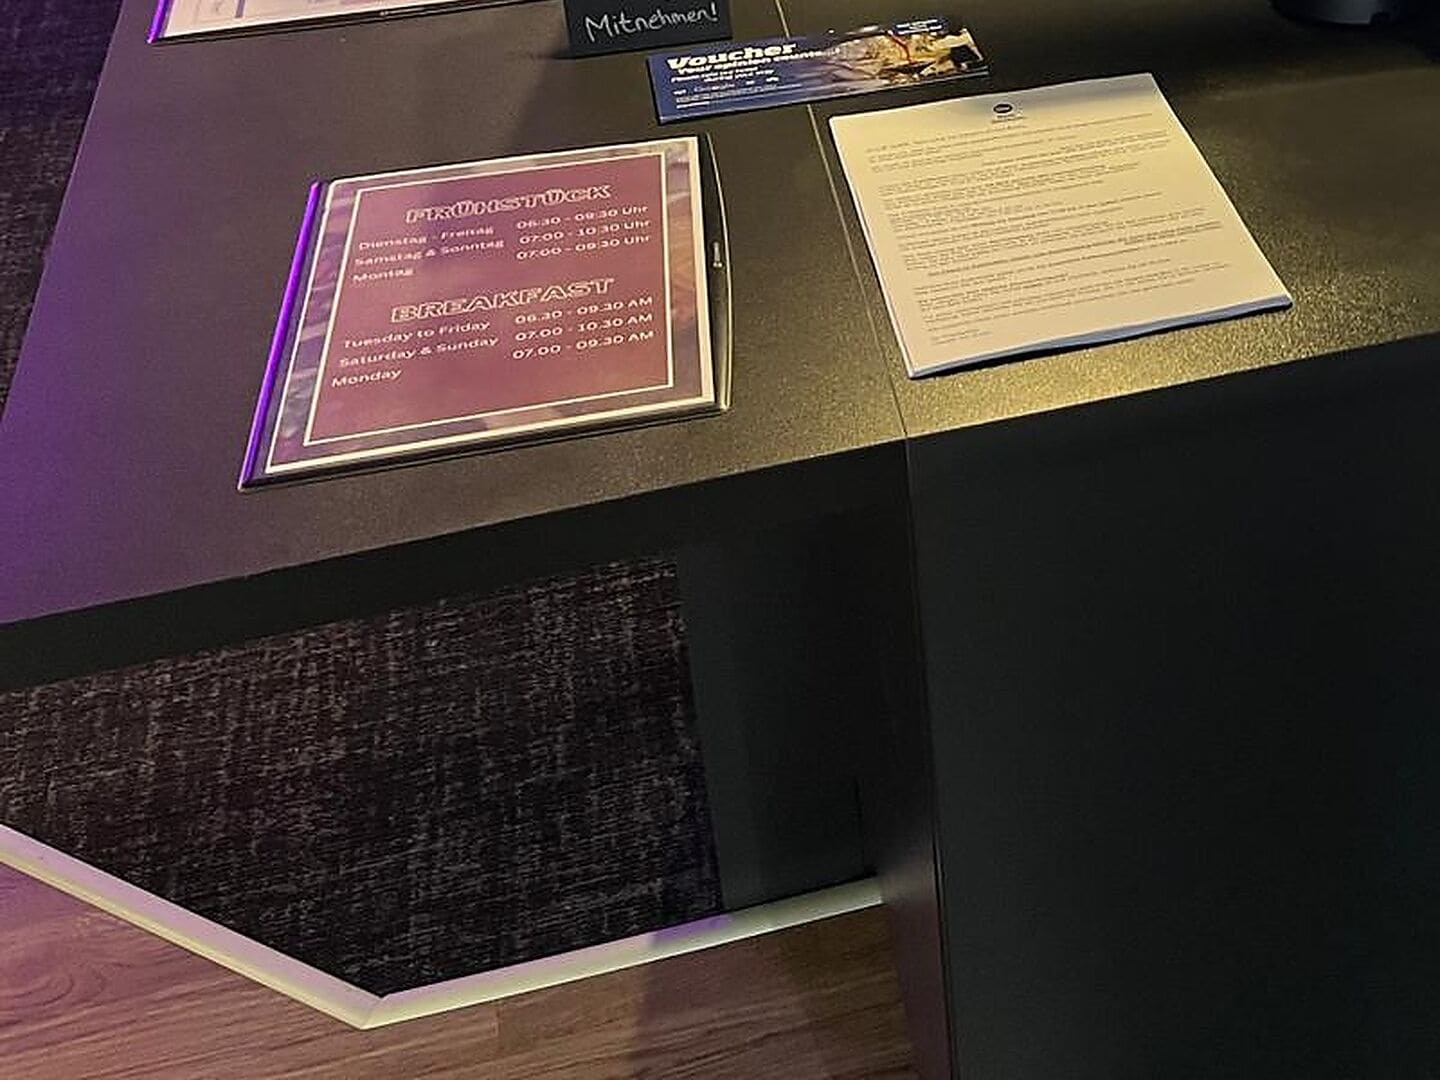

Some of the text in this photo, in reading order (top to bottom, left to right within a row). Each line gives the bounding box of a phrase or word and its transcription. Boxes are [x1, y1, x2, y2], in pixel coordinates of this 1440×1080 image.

[585, 1, 718, 42] Mitnehmen!
[667, 43, 797, 70] Voucher
[404, 184, 612, 224] FRÜHSTÜCK
[354, 250, 422, 266] Samstag
[425, 248, 436, 257] &
[441, 238, 505, 256] Sonntag
[624, 220, 651, 231] Uhr
[358, 234, 427, 251] Dienstag
[440, 225, 495, 242] Freitag
[623, 205, 649, 216] Uhr
[352, 267, 414, 283] Montag
[624, 234, 651, 246] Uhr
[345, 330, 413, 348] Tuesday
[418, 327, 435, 338] to
[439, 321, 491, 336] Friday
[629, 296, 653, 308] AM
[391, 278, 615, 323] BREAKFAST
[331, 370, 402, 388] Monday
[628, 330, 654, 341] AM
[340, 349, 418, 368] Saturday
[421, 346, 432, 355] &
[437, 335, 500, 353] Sunday
[628, 313, 653, 324] AM
